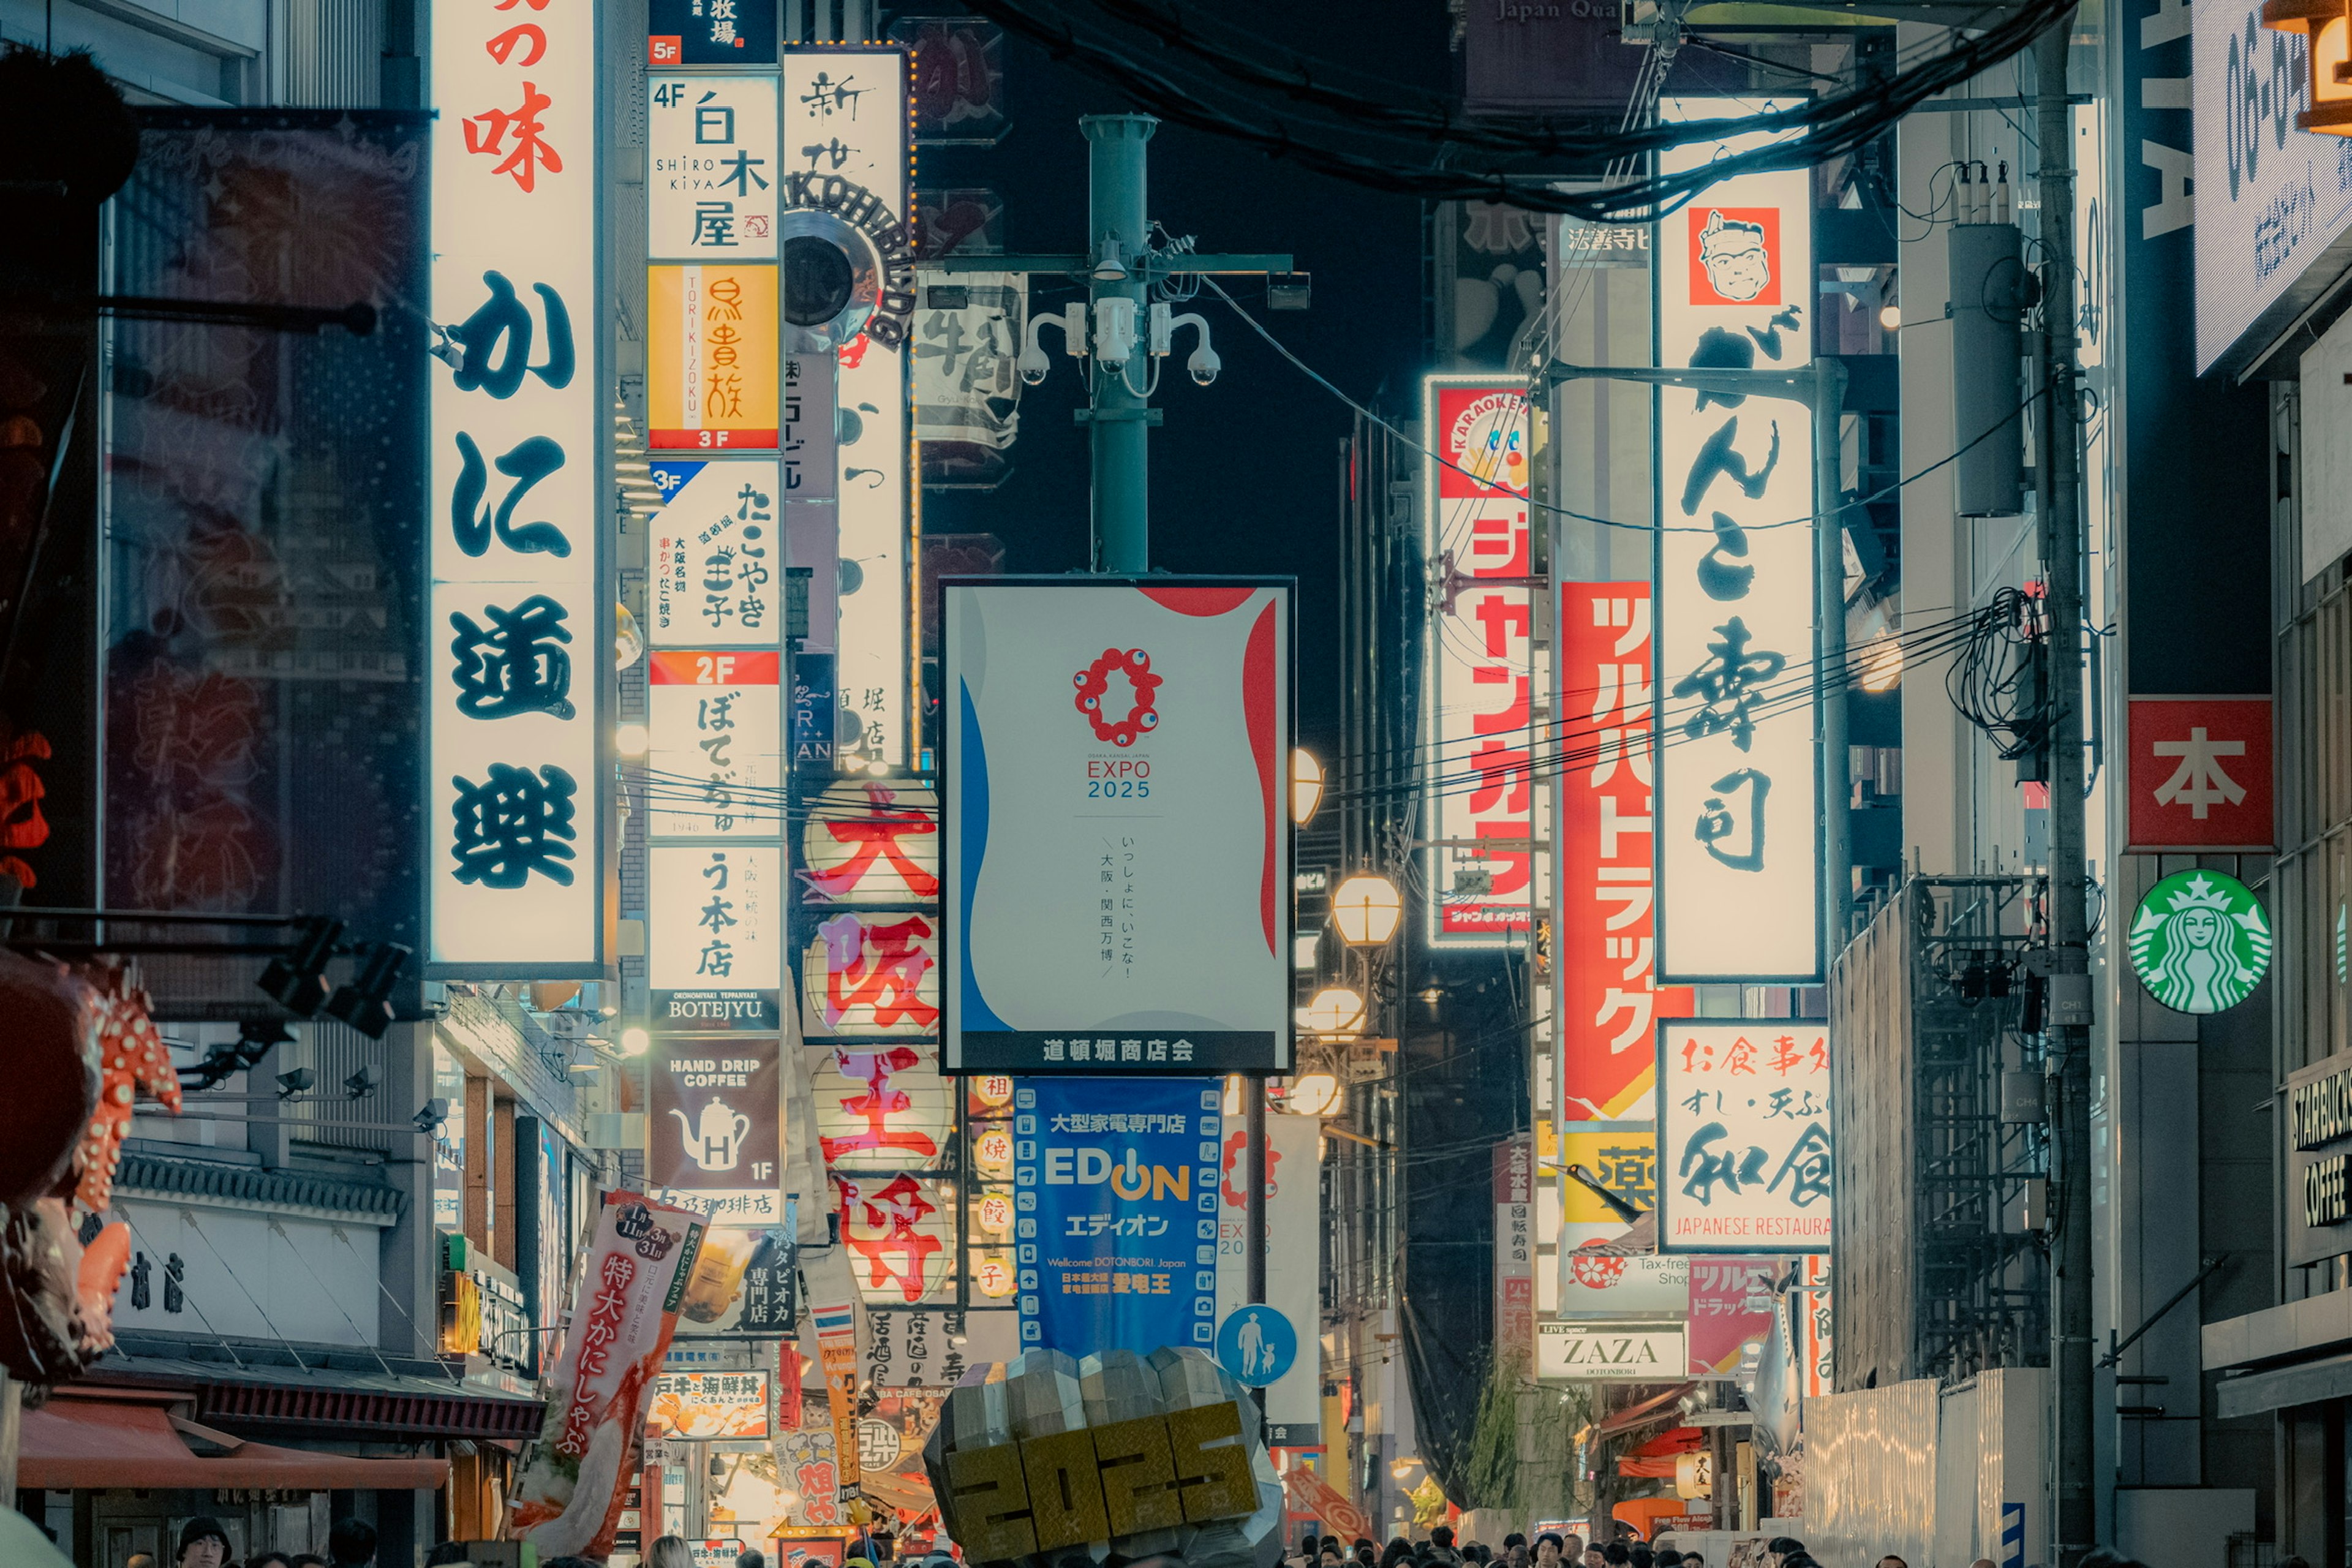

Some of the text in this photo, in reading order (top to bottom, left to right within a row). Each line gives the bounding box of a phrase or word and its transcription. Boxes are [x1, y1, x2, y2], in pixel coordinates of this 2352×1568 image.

[710, 0, 737, 44] 牧場
[654, 43, 676, 59] 5F
[462, 0, 562, 193] の味
[654, 83, 685, 108] 4F
[691, 91, 770, 246] 白木屋
[688, 277, 697, 412] TORIKIZOKU
[1454, 395, 1518, 450] KARAOKE
[653, 470, 681, 491] 3F
[674, 537, 687, 593] 大阪名物
[737, 483, 772, 628] たこやき
[696, 657, 736, 684] 2F
[1088, 761, 1150, 778] EXPO
[2153, 727, 2247, 819] 本
[1088, 781, 1150, 797] 2025
[670, 1060, 760, 1072] HAND DRIP
[1043, 1039, 1194, 1063] 道頓堀商店会
[684, 1074, 747, 1087] COFFEE
[1681, 1087, 1830, 1120] すし・天ぷ
[2293, 1066, 2352, 1152] STARBUCKS
[1050, 1113, 1186, 1134] 大型家電専門店
[752, 1163, 772, 1180] 1F
[1045, 1148, 1190, 1201] EDION
[1678, 1121, 1830, 1208] 和食
[2304, 1153, 2346, 1228] COFFEE
[1065, 1213, 1169, 1236] エディオン
[1511, 1204, 1527, 1262] 回転寿司
[1676, 1217, 1751, 1235] JAPANESE
[1157, 1259, 1186, 1270] Japan
[749, 1267, 769, 1324] 専門店
[1544, 1325, 1587, 1336] LIVE space
[556, 1254, 633, 1455] 特大かにしゃぶ
[1563, 1339, 1659, 1364] ZAZA
